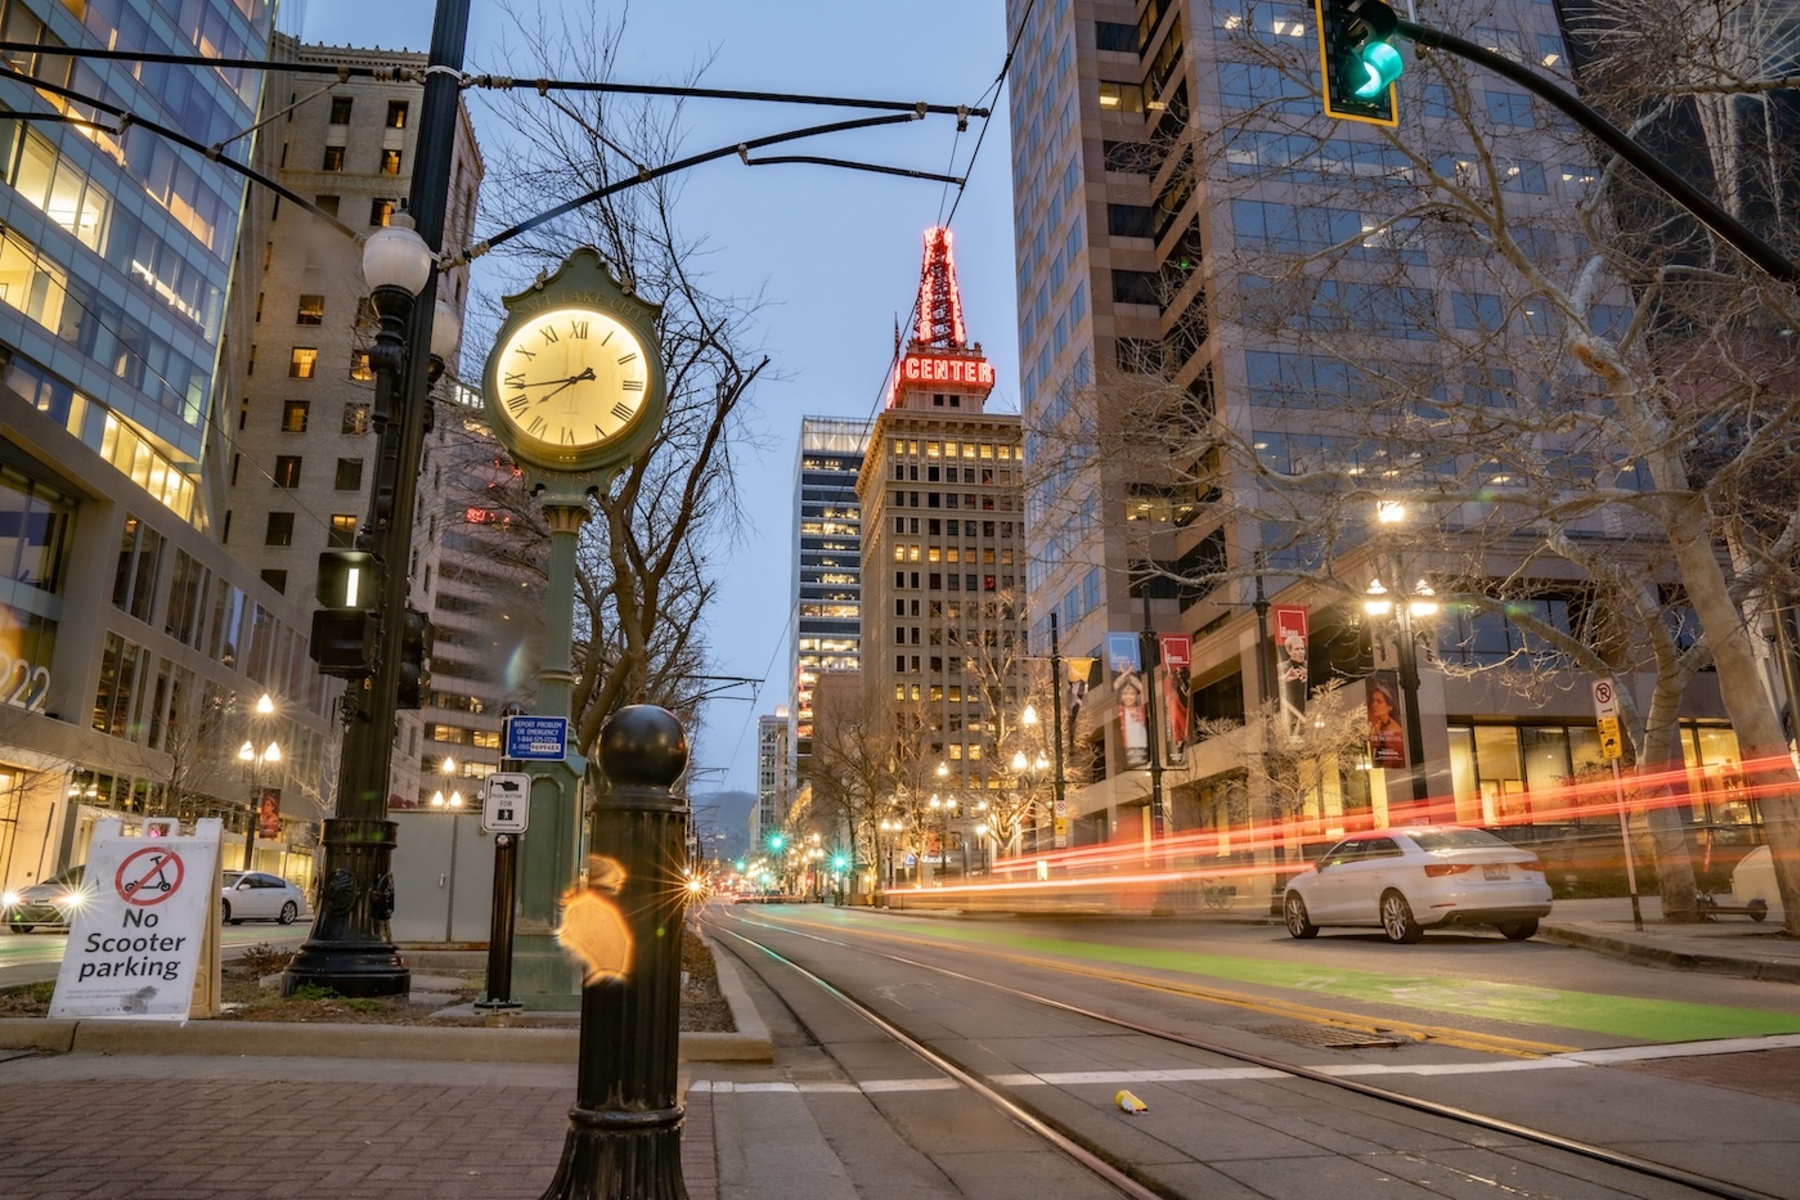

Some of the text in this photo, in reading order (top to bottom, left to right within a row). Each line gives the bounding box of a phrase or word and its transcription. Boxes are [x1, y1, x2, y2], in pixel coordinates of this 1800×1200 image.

[515, 290, 646, 321] SALT LAKE CITY
[569, 320, 589, 340] XII
[905, 357, 993, 384] CENTER
[122, 908, 159, 928] No
[84, 932, 186, 953] Scooter
[78, 956, 181, 983] parking
